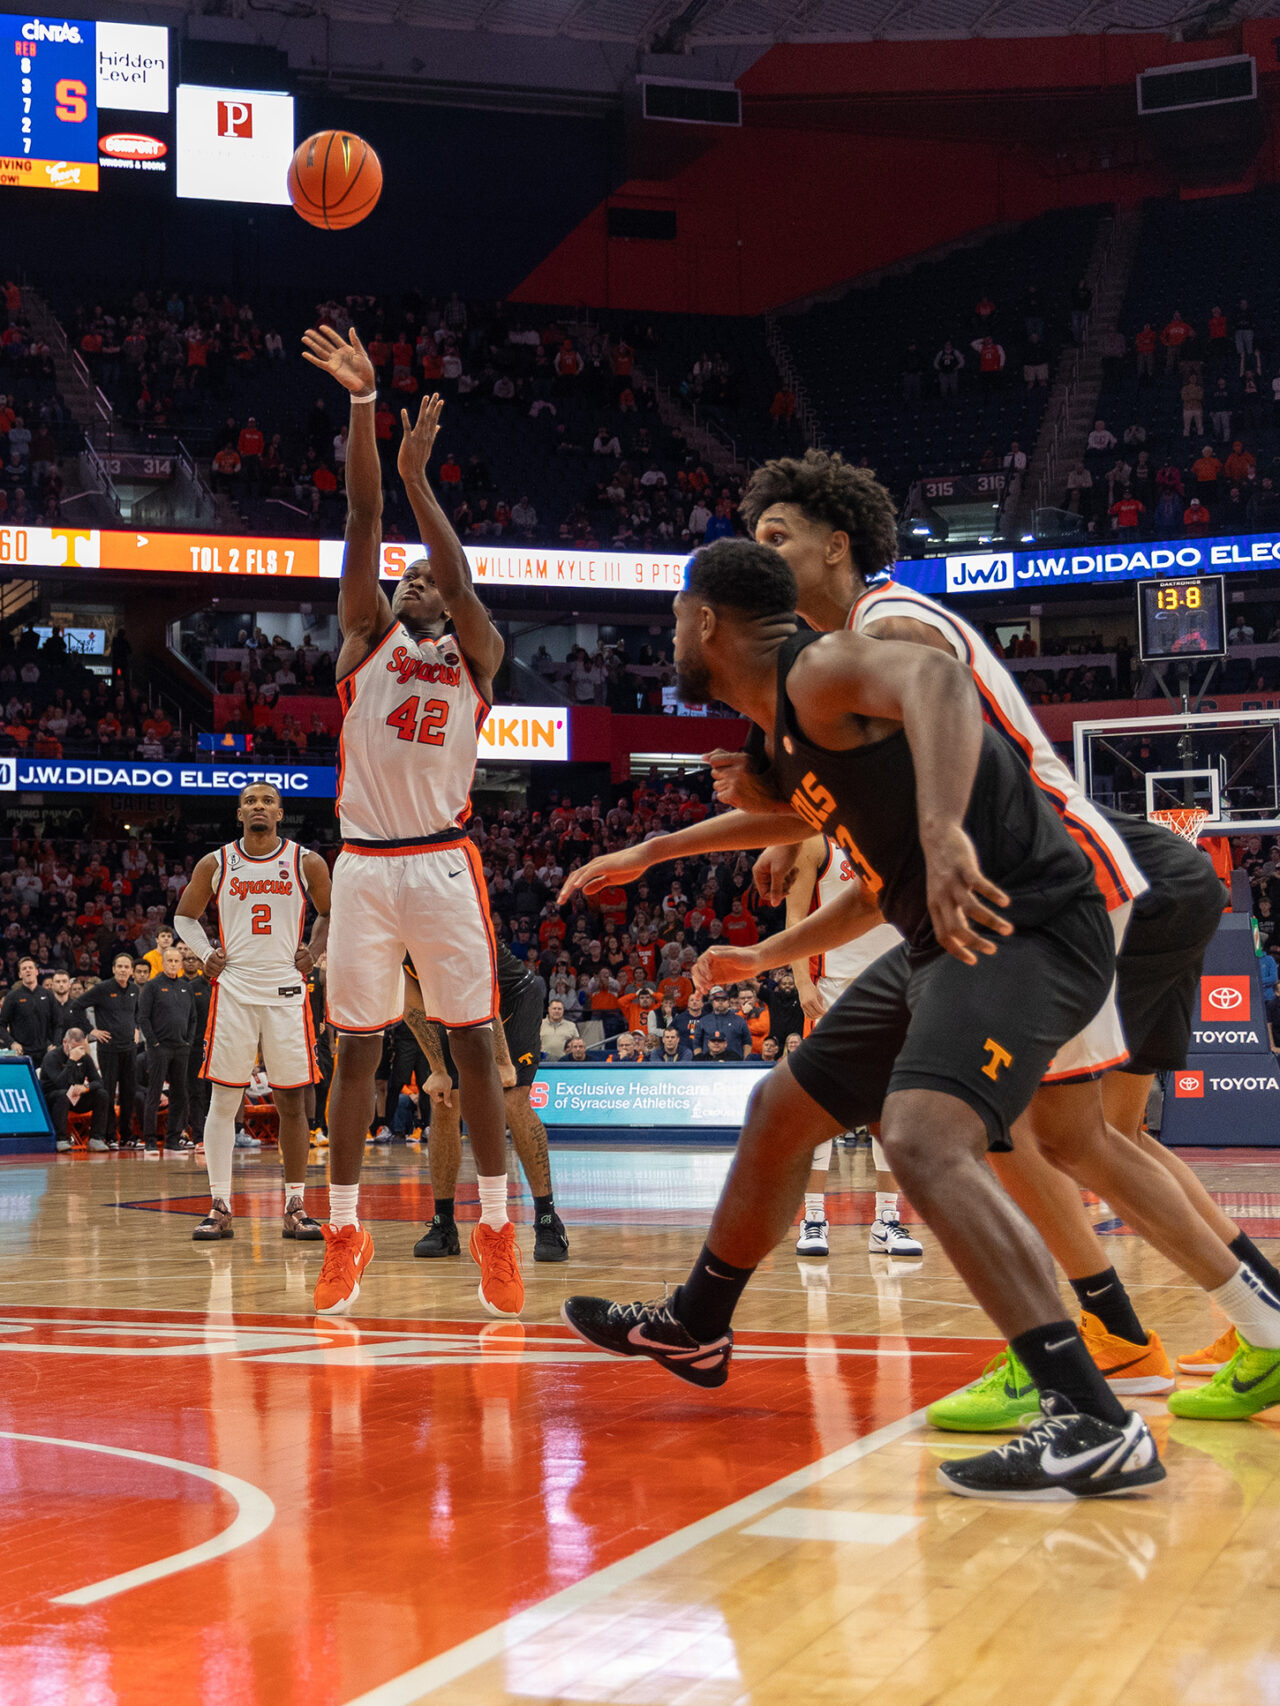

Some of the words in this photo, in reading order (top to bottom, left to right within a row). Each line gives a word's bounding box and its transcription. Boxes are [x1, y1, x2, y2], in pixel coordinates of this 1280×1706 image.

[15, 40, 37, 57] REB
[99, 51, 165, 69] Hidden
[99, 66, 147, 83] Level
[21, 78, 32, 94] 3
[22, 97, 32, 114] 7
[55, 78, 87, 123] S
[21, 117, 31, 134] 2
[223, 102, 249, 137] P
[22, 137, 32, 154] 7
[144, 459, 171, 474] 314
[926, 481, 954, 498] 315
[977, 475, 1006, 491] 316
[0, 529, 28, 562] 60
[51, 527, 91, 567] T
[190, 546, 223, 573] TOL
[229, 548, 240, 573] 2
[246, 548, 278, 575] FLS
[284, 550, 295, 575] 7
[383, 546, 406, 577] S
[475, 556, 548, 580] WILLIAM
[556, 559, 596, 582] KYLE
[604, 562, 621, 583] III
[634, 563, 644, 583] 9
[651, 563, 682, 586] PTS
[1157, 586, 1201, 610] 13.8
[385, 695, 450, 747] 42
[478, 718, 562, 748] NKIN'
[180, 770, 309, 790] ELECTRIC
[790, 771, 838, 832] OLS
[229, 877, 293, 901] Syracuse
[252, 904, 272, 935] 2
[1193, 1031, 1259, 1044] TOYOTA
[981, 1037, 1013, 1082] T
[556, 1082, 625, 1096] Exclusive
[628, 1082, 708, 1096] Healthcare
[1209, 1077, 1280, 1091] TOYOTA
[530, 1082, 549, 1109] S
[554, 1097, 567, 1109] of
[570, 1098, 631, 1111] Syracuse
[632, 1097, 690, 1109] Athletics
